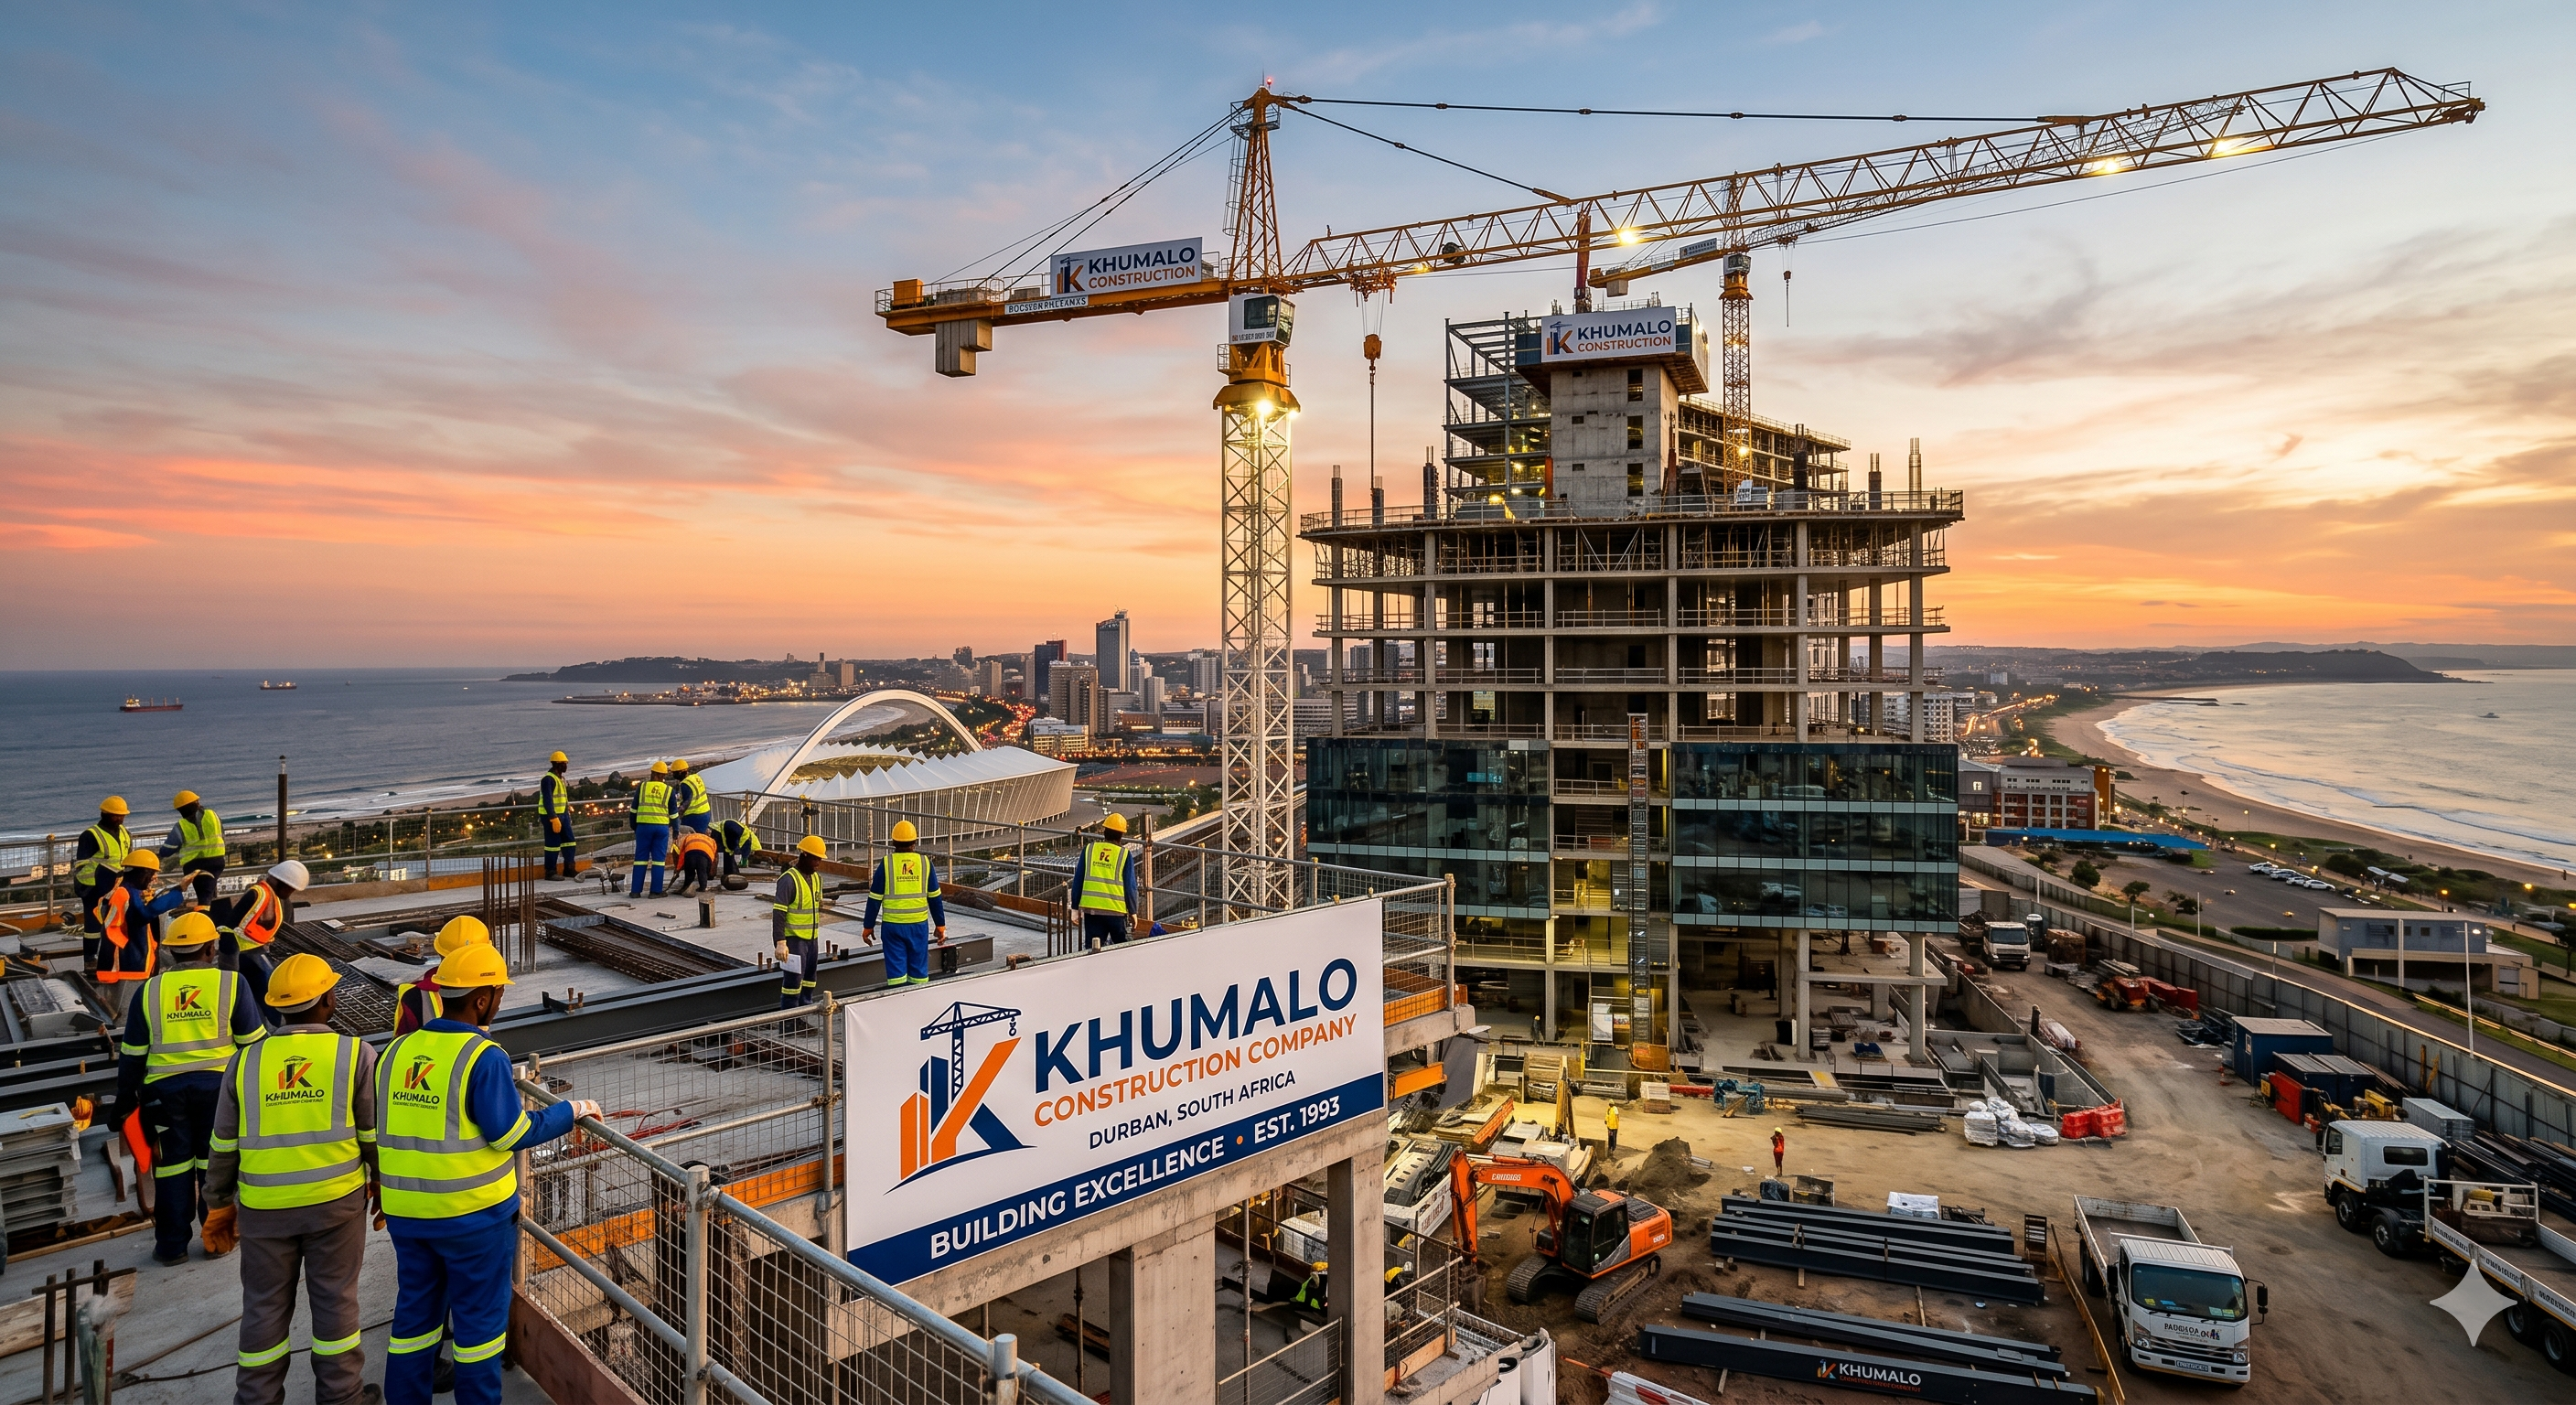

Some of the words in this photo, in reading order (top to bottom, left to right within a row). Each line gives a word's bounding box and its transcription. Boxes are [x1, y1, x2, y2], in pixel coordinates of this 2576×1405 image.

[1089, 247, 1196, 274] KHUMALO
[1089, 265, 1196, 289] CONSTRUCTION
[1577, 319, 1672, 340] KHUMALO
[1577, 336, 1671, 352] CONSTRUCTION
[1035, 958, 1358, 1094] KHUMALO
[1034, 1047, 1242, 1128] CONSTRUCTION
[1247, 1014, 1358, 1065] COMPANY
[392, 1090, 440, 1104] KHUMALO
[1089, 1109, 1174, 1150] DURBAN,
[1177, 1089, 1234, 1121] SOUTH
[1238, 1070, 1296, 1102] AFRICA
[930, 1190, 1066, 1260] BUILDING
[1075, 1135, 1225, 1208] EXCELLENCE
[1254, 1111, 1295, 1144] EST.
[1299, 1095, 1341, 1127] 1993
[1839, 1363, 1921, 1386] KHUMALO
